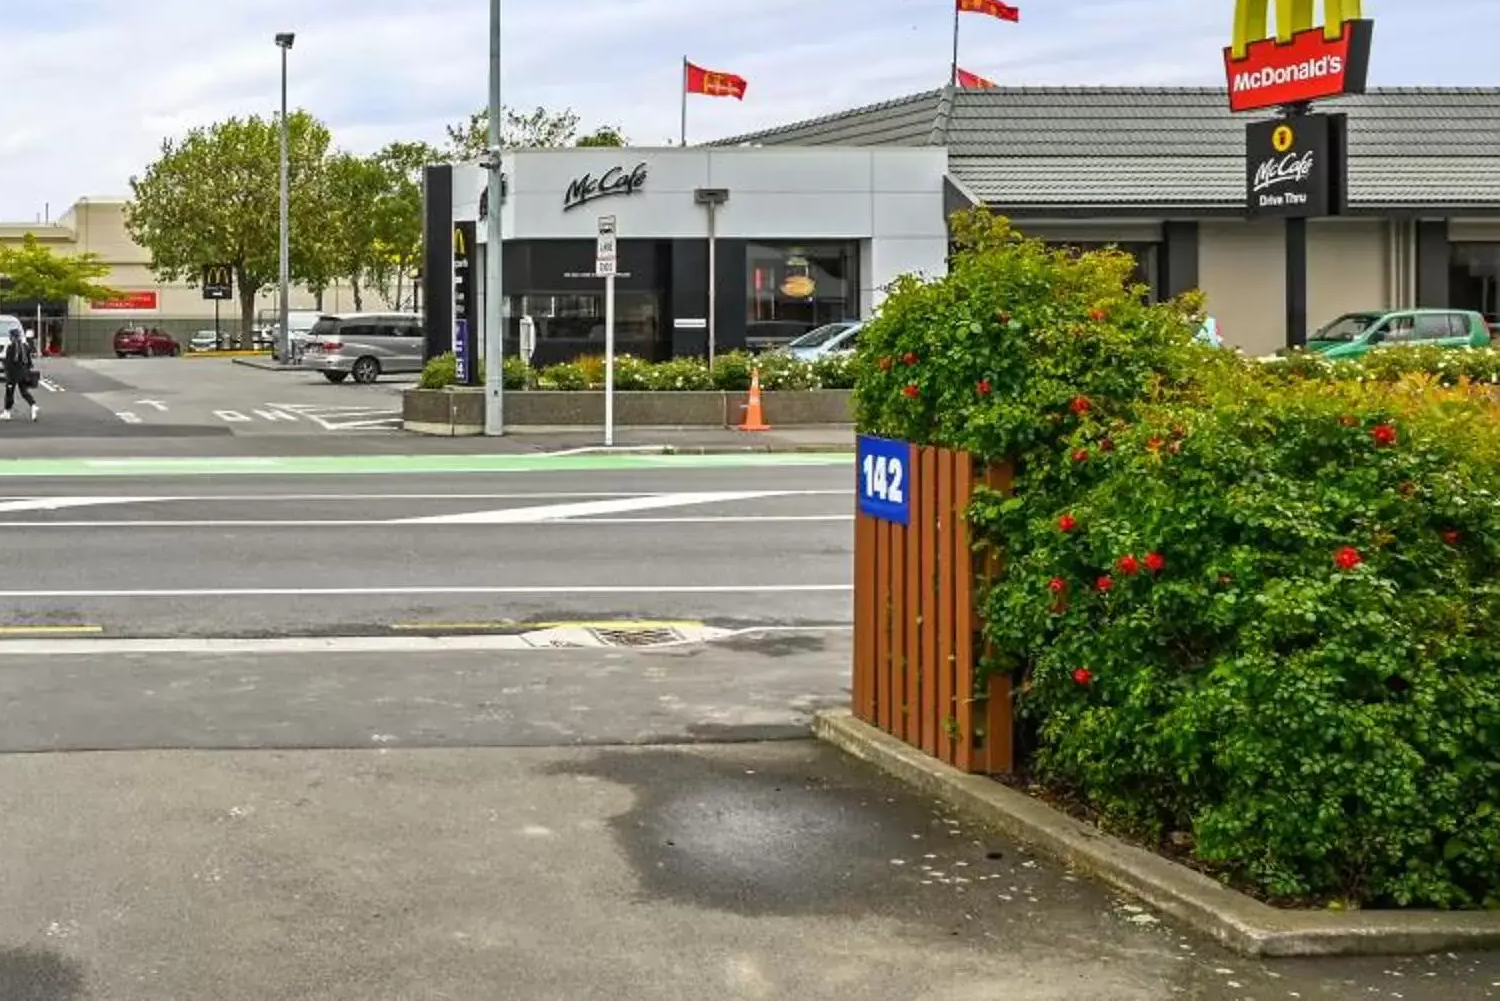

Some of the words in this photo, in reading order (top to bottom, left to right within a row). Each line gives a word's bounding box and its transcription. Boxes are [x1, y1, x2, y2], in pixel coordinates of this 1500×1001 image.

[1233, 54, 1343, 93] McDonald's
[1259, 194, 1284, 207] Drive
[1284, 192, 1307, 204] Thru
[863, 454, 903, 503] 142
